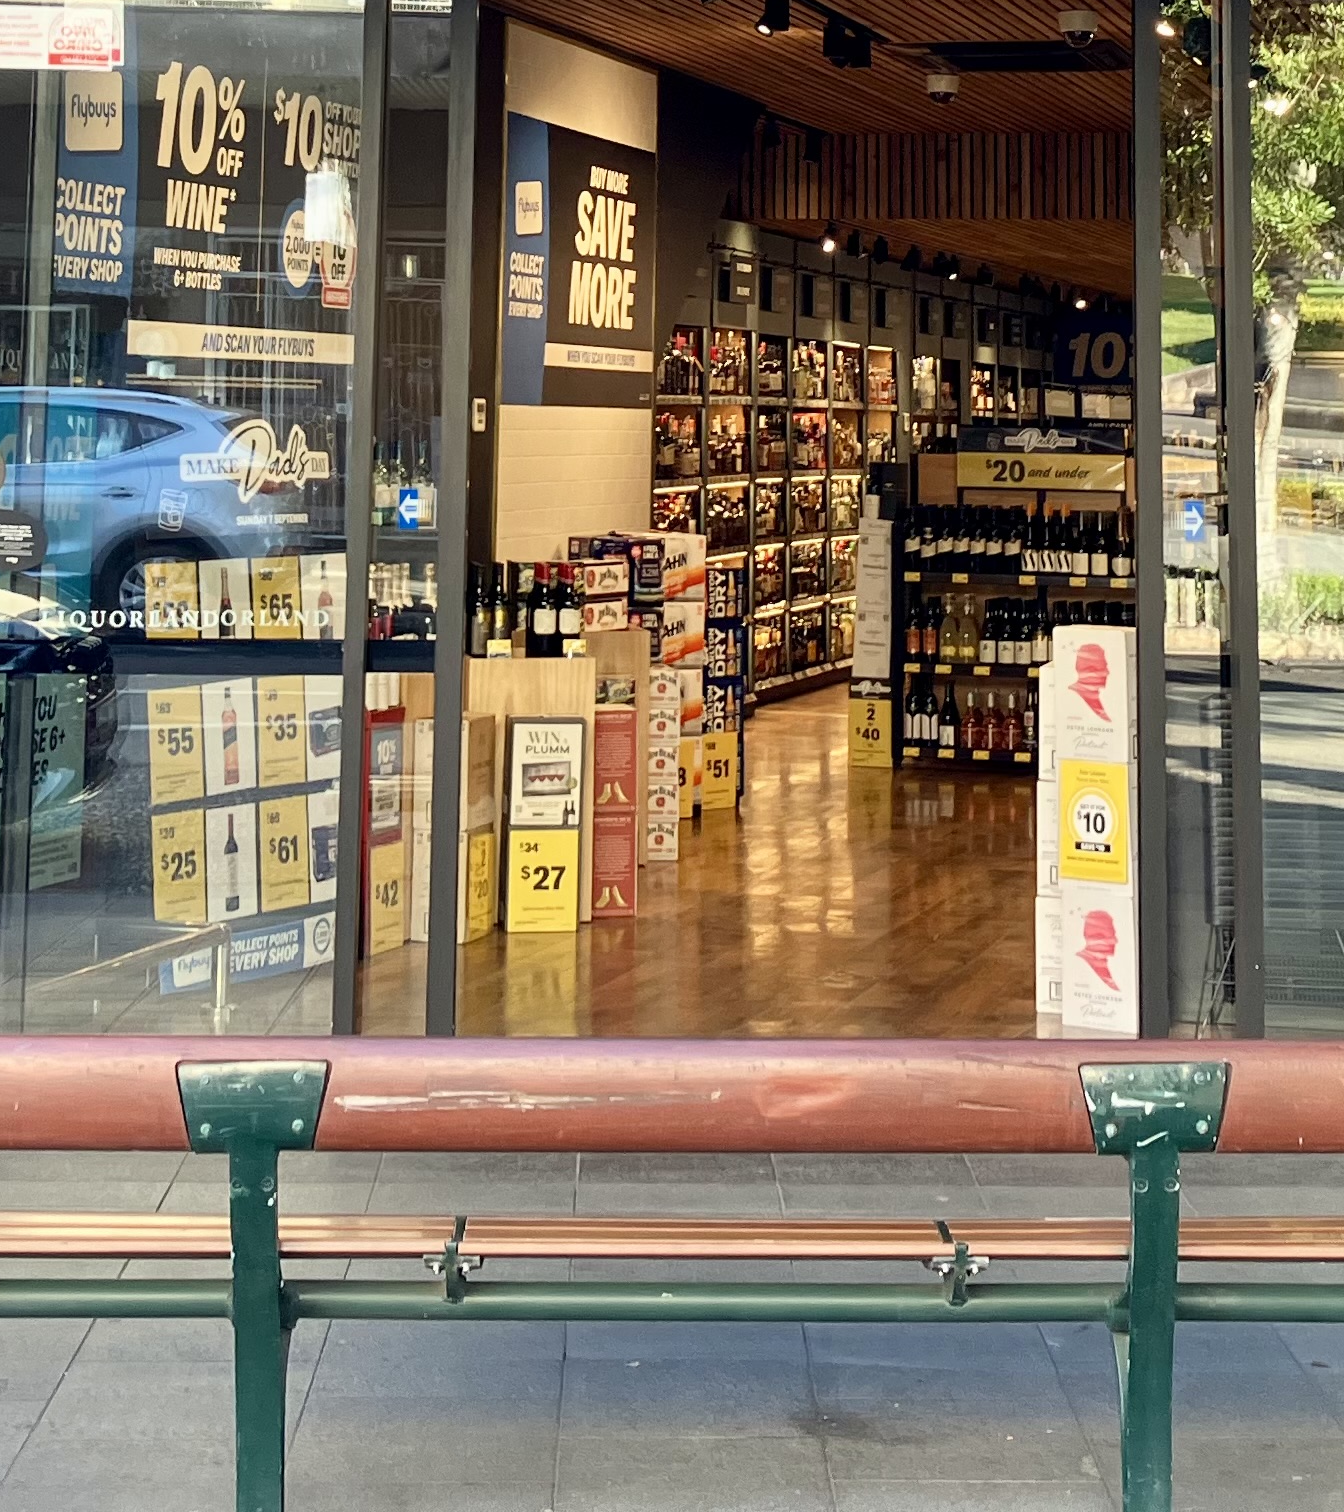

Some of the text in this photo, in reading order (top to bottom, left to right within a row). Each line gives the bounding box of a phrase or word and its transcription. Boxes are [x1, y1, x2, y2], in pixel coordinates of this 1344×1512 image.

[71, 94, 116, 127] flybuys
[156, 61, 245, 175] 10%
[325, 101, 341, 119] OFF
[274, 87, 323, 171] $10
[323, 125, 361, 159] SHOP
[216, 146, 244, 178] OFF
[590, 165, 630, 195] BUY MORE
[57, 177, 126, 216] COLLECT
[55, 213, 124, 256] POINTS
[574, 190, 637, 263] SAVE
[89, 258, 123, 283] SHOP
[154, 246, 241, 273] WHEN YOU PURCHASE
[287, 259, 309, 272] POINTS
[331, 263, 346, 281] OFF
[510, 251, 544, 276] COLLECT
[174, 271, 222, 291] 6+ BOTTLES
[508, 274, 543, 301] POINTS
[568, 260, 637, 330] MORE
[201, 333, 315, 356] AND SCAN YOUR FLYBUYS
[1068, 331, 1134, 379] 10
[186, 457, 240, 476] MAKE
[224, 425, 310, 497] Dad's
[311, 457, 326, 473] DAY
[986, 459, 1090, 482] $20 and under
[236, 514, 268, 526] SUNDAY
[260, 593, 293, 620] $65
[707, 571, 715, 619] CARLTON
[715, 568, 727, 619] DRY
[707, 627, 715, 678] CARLTON
[715, 627, 726, 678] DRY
[714, 685, 725, 733] DRY
[49, 725, 66, 751] 6+
[266, 713, 297, 741] $35
[528, 731, 562, 745] WIN
[856, 727, 880, 741] $40
[157, 727, 194, 756] $55
[525, 745, 570, 754] PLUMM
[706, 759, 729, 779] $51
[1077, 811, 1105, 834] $10
[269, 834, 298, 864] $61
[161, 849, 197, 881] $25
[521, 865, 566, 890] $27
[375, 879, 398, 908] $42
[268, 929, 298, 947] POINTS
[268, 944, 299, 965] SHOP
